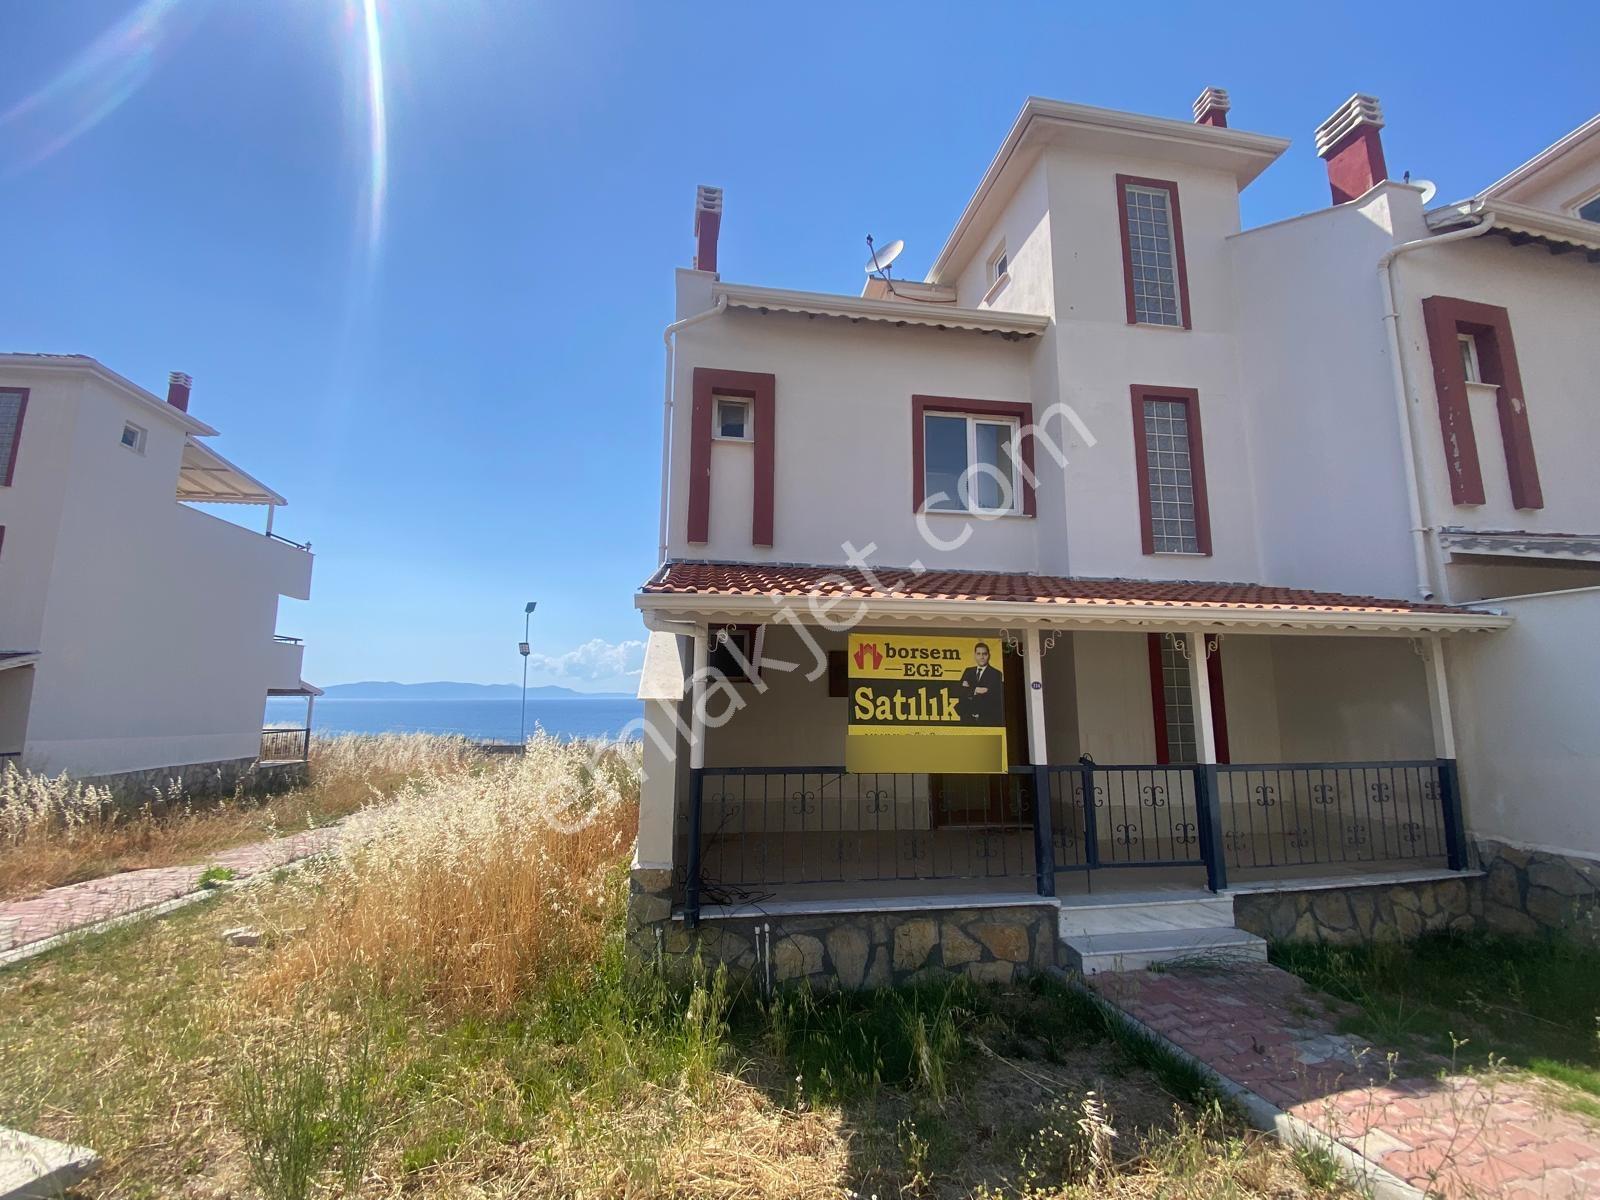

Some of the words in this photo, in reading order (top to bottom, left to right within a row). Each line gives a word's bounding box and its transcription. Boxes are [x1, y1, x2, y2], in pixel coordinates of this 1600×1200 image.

[885, 643, 961, 660] borsem
[904, 663, 943, 677] EGE
[855, 687, 961, 721] Satılık
